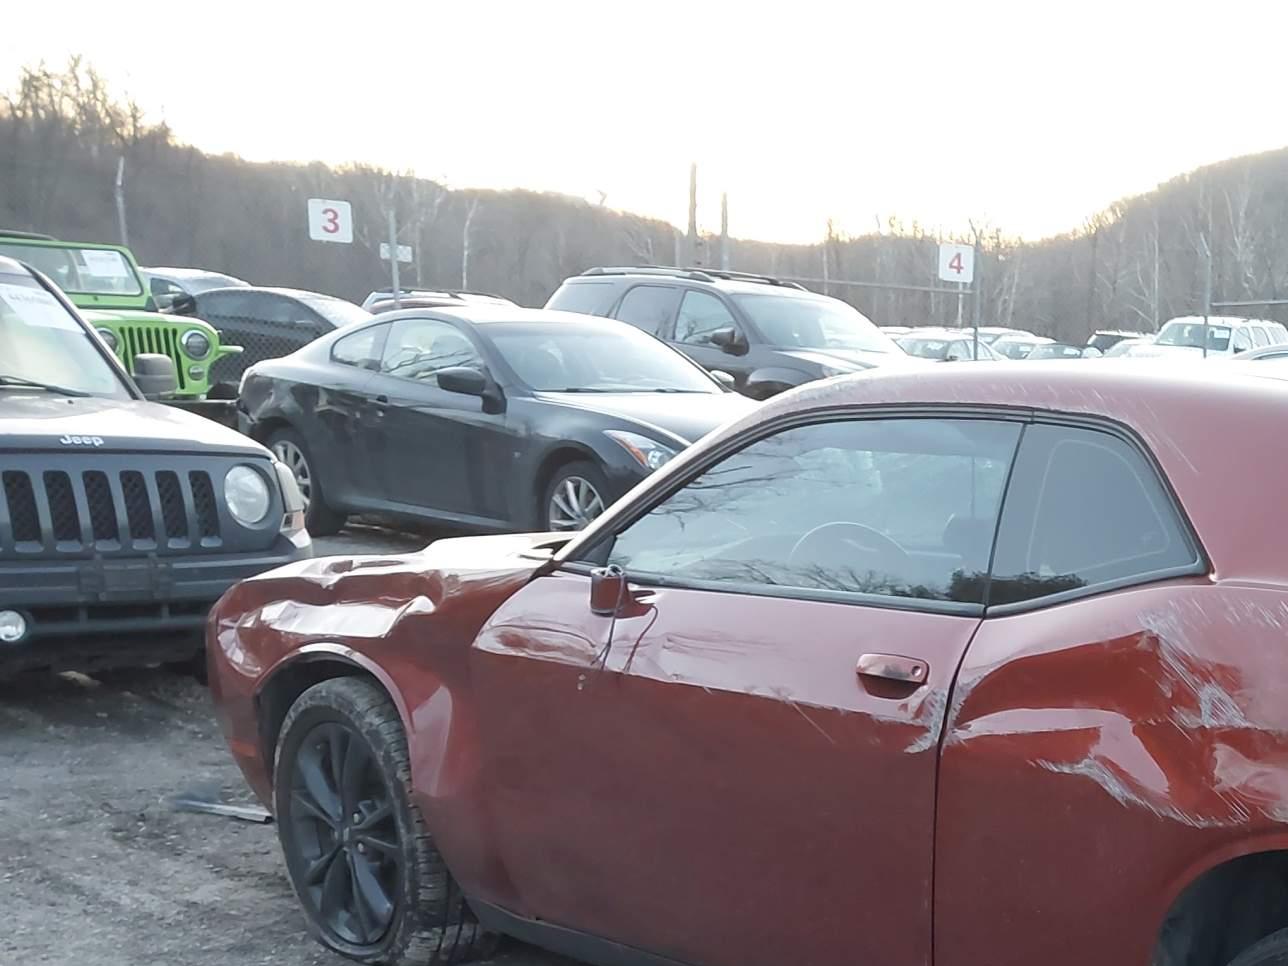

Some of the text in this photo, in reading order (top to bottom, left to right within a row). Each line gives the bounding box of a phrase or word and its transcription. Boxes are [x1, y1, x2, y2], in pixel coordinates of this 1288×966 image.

[321, 207, 340, 234] 3
[948, 252, 965, 274] 4
[59, 434, 104, 447] Jeep
